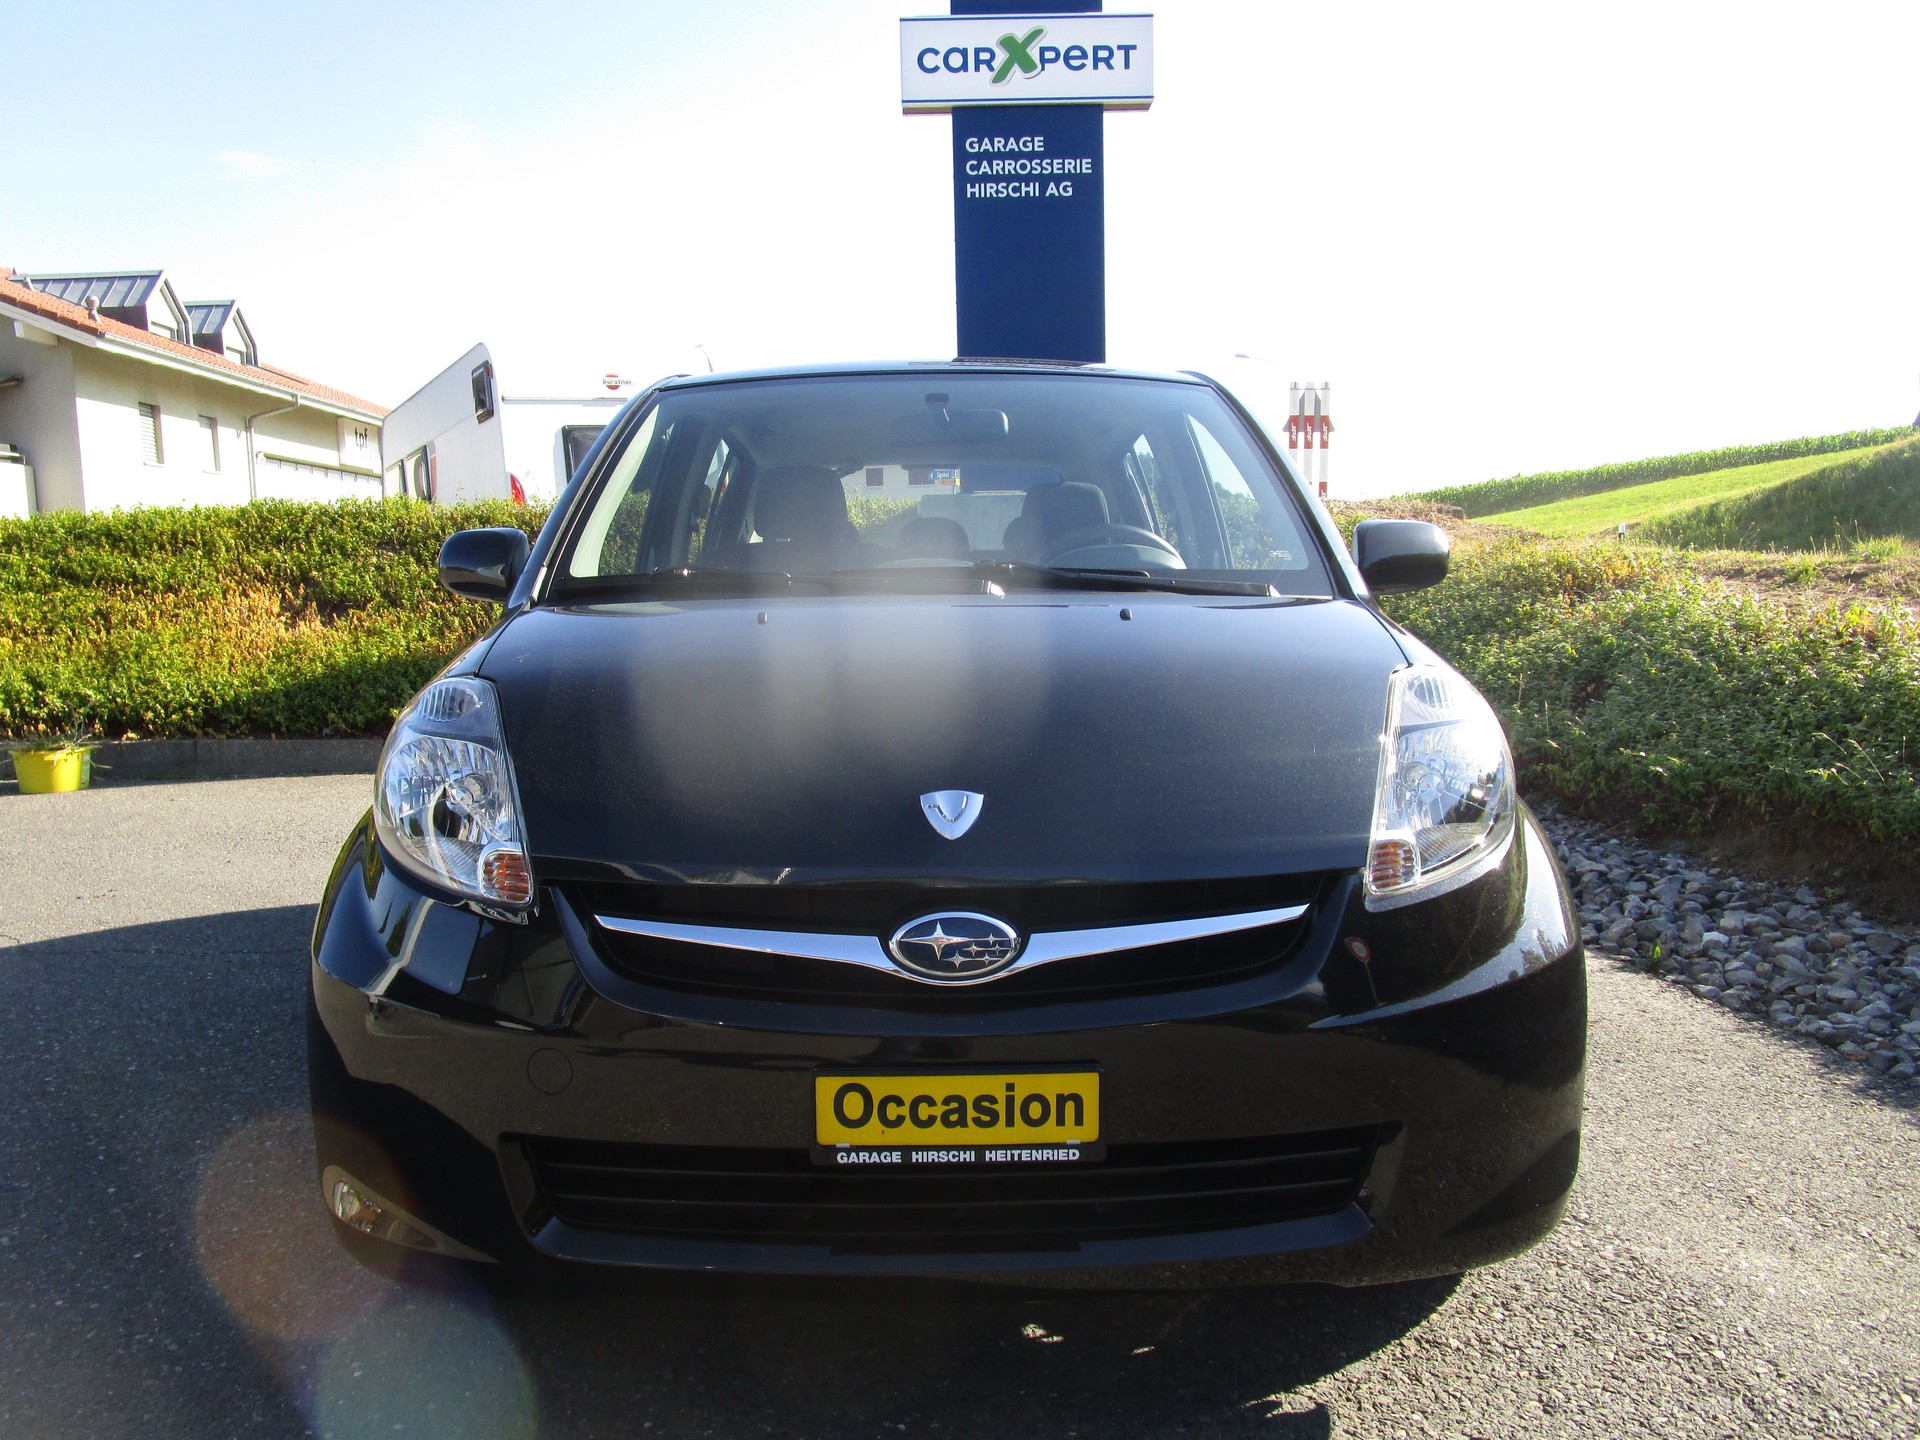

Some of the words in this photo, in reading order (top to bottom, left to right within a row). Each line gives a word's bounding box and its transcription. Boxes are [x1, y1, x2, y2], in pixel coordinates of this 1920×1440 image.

[965, 137, 1044, 152] GARAGE
[965, 159, 1092, 175] CARROSSERIE
[966, 182, 1040, 198] HIRSCHI
[1045, 181, 1073, 197] AG
[833, 1082, 1084, 1129] Occasion
[836, 1151, 902, 1164] GARAGE
[911, 1150, 976, 1163] HIRSCHI
[985, 1148, 1080, 1162] HEITENRIED
